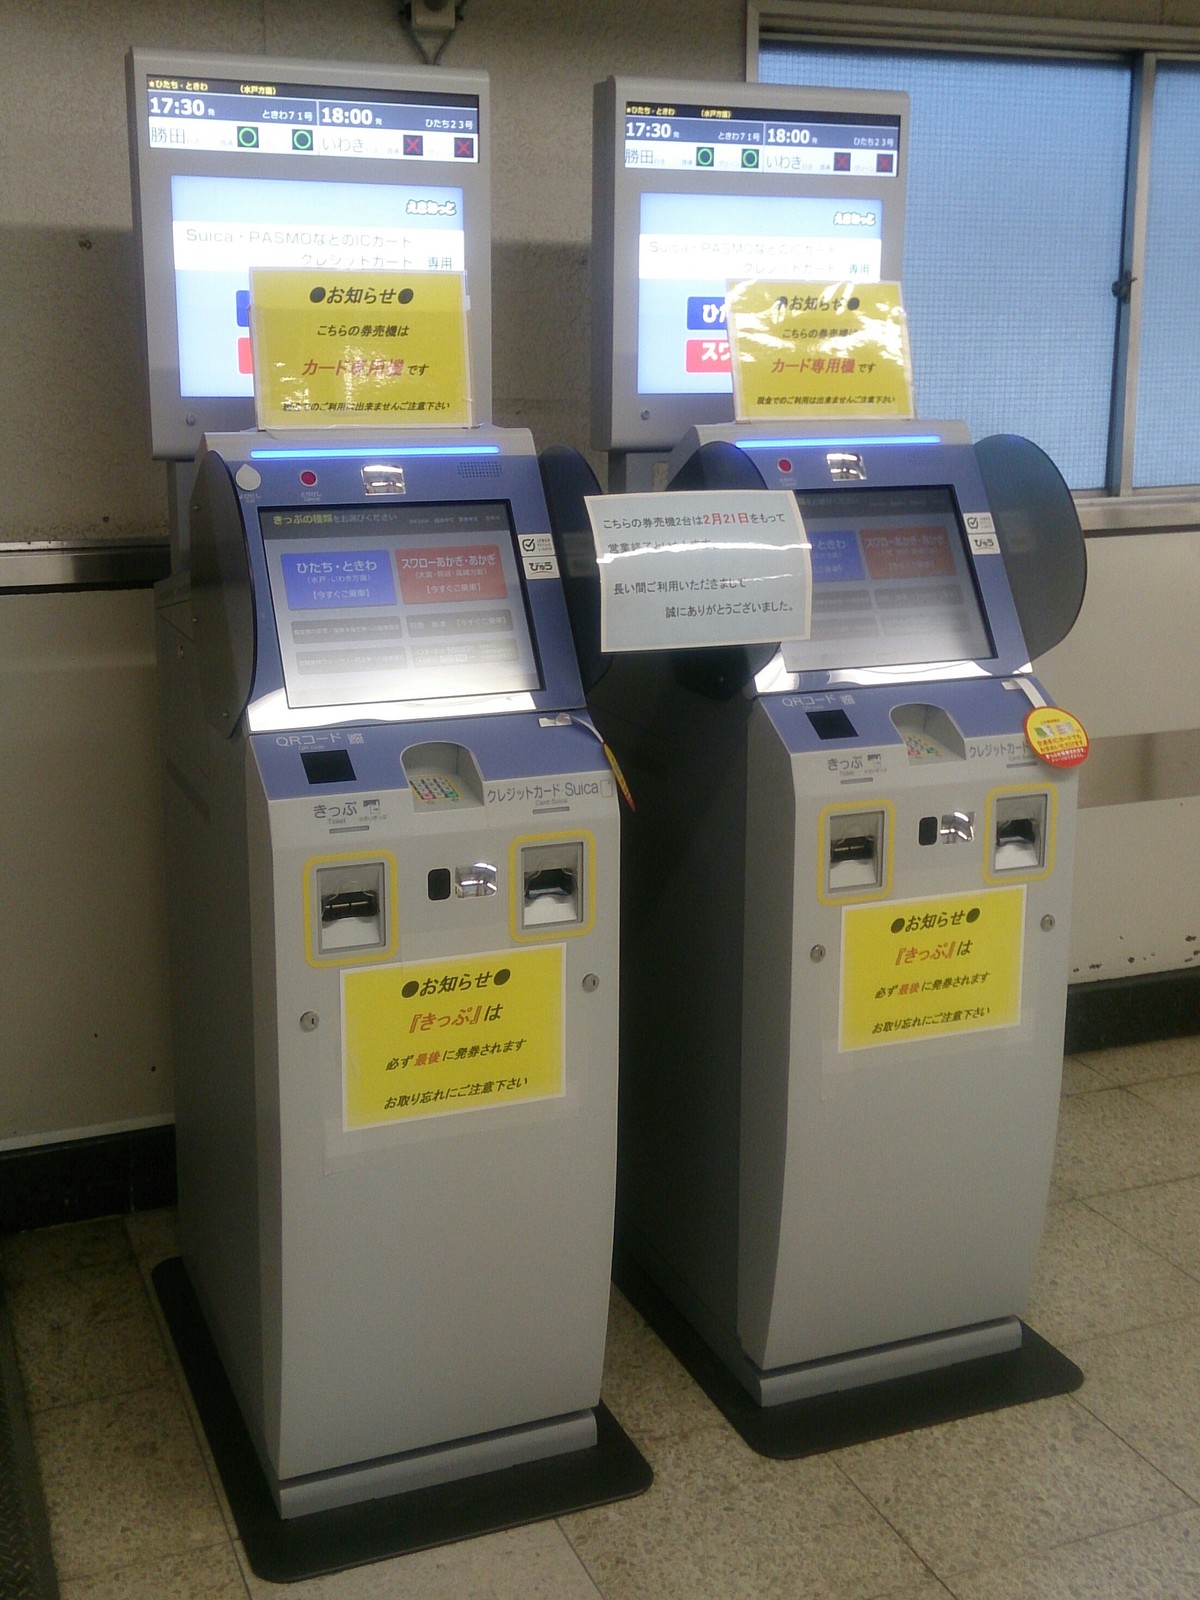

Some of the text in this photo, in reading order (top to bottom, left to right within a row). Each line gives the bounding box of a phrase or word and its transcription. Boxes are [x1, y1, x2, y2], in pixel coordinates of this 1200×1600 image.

[150, 96, 205, 116] 17:30
[262, 110, 313, 122] ときわ71号
[321, 107, 372, 125] 18:00
[425, 119, 473, 130] ひたち23号
[151, 126, 185, 145] 勝田
[626, 122, 671, 138] 17:30
[767, 128, 810, 144] 18:00
[322, 136, 364, 153] いわき
[625, 148, 653, 164] 勝田
[766, 155, 801, 170] いわき
[317, 325, 410, 338] こちらの券売機は
[603, 512, 786, 530] こちらの券売機2台は2月21日をもって
[296, 560, 378, 574] ひたち・ときわ
[401, 553, 496, 569] スワローあかぎ・あかぎ
[613, 577, 747, 596] 長い間ご利用いただきまして
[665, 600, 794, 619] 誠にありがとうございました。
[782, 694, 836, 707] QRコード
[275, 732, 342, 747] QRコード
[827, 755, 863, 771] きっぷ
[488, 782, 599, 803] クレジットカード Suica
[313, 801, 357, 819] きっぷ
[872, 1007, 990, 1035] お取り忘れにご注意下さい
[384, 1077, 528, 1110] お取り忘れにご注意下さい
